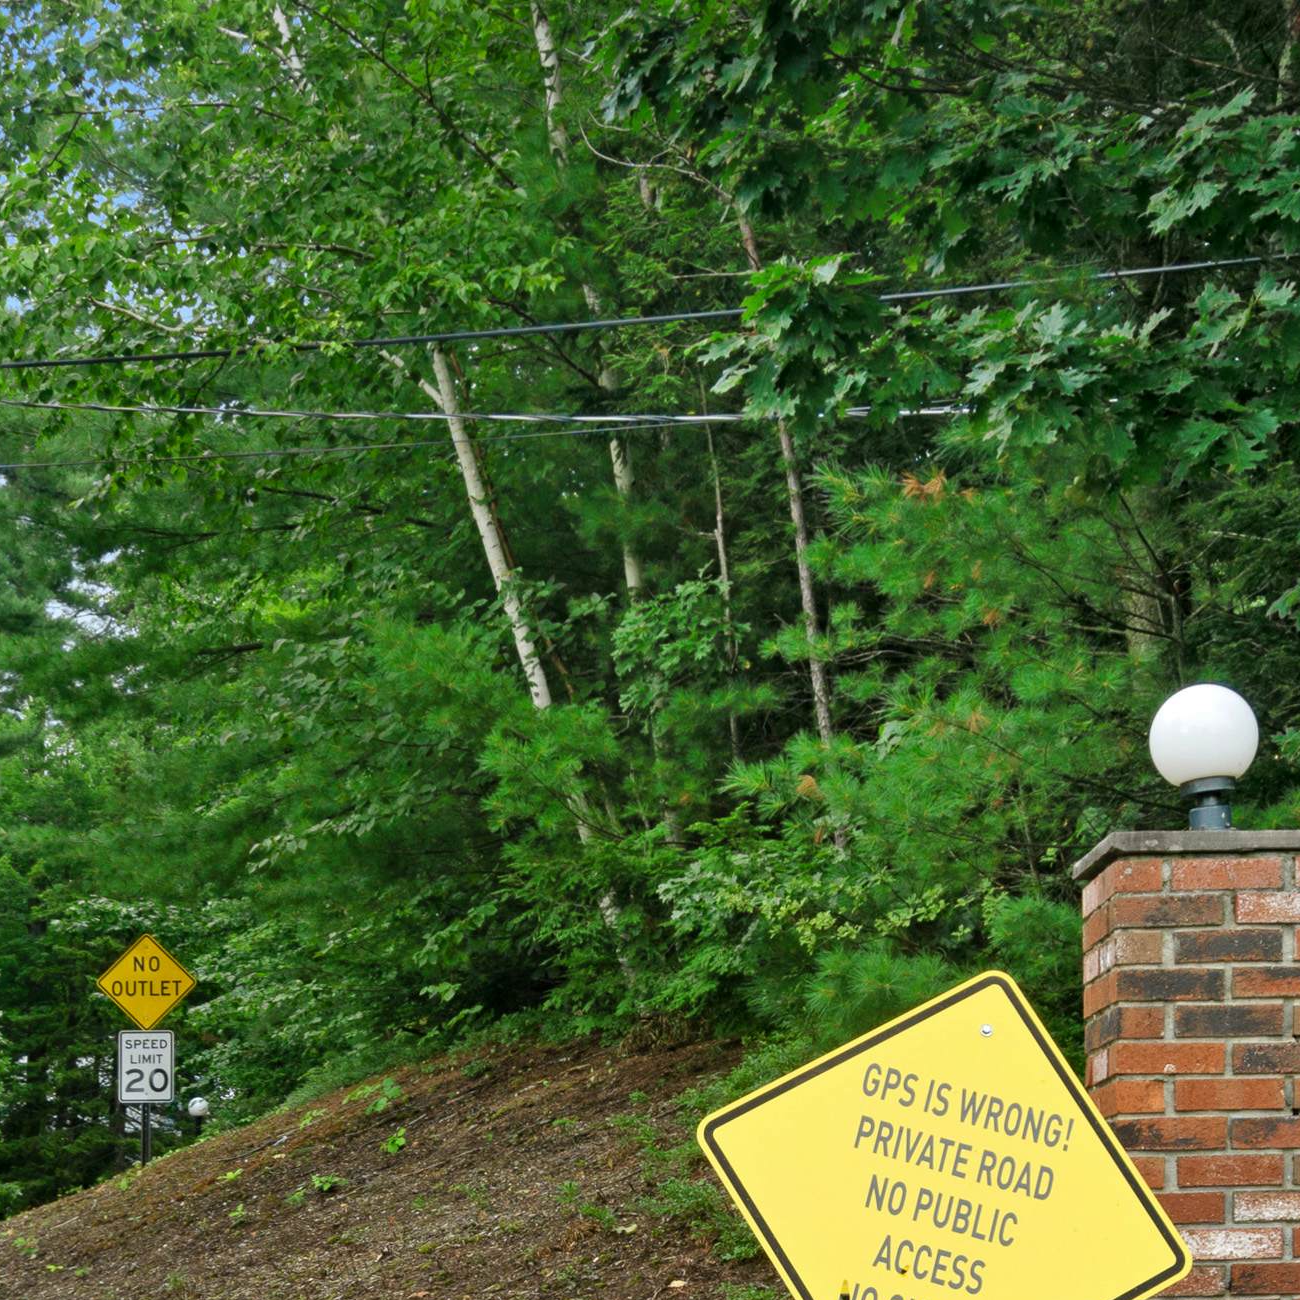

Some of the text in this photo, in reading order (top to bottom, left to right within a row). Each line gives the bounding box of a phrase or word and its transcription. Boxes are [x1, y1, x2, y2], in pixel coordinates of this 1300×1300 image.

[133, 956, 160, 972] NO
[111, 980, 182, 997] OUTLET
[125, 1039, 168, 1049] SPEED
[130, 1054, 163, 1064] LIMIT
[125, 1068, 168, 1093] 20
[862, 1063, 1075, 1151] GPS IS WRONG!
[854, 1115, 1054, 1200] PRIVATE ROAD
[865, 1174, 1019, 1247] NO PUBLIC
[872, 1235, 986, 1295] ACCESS
